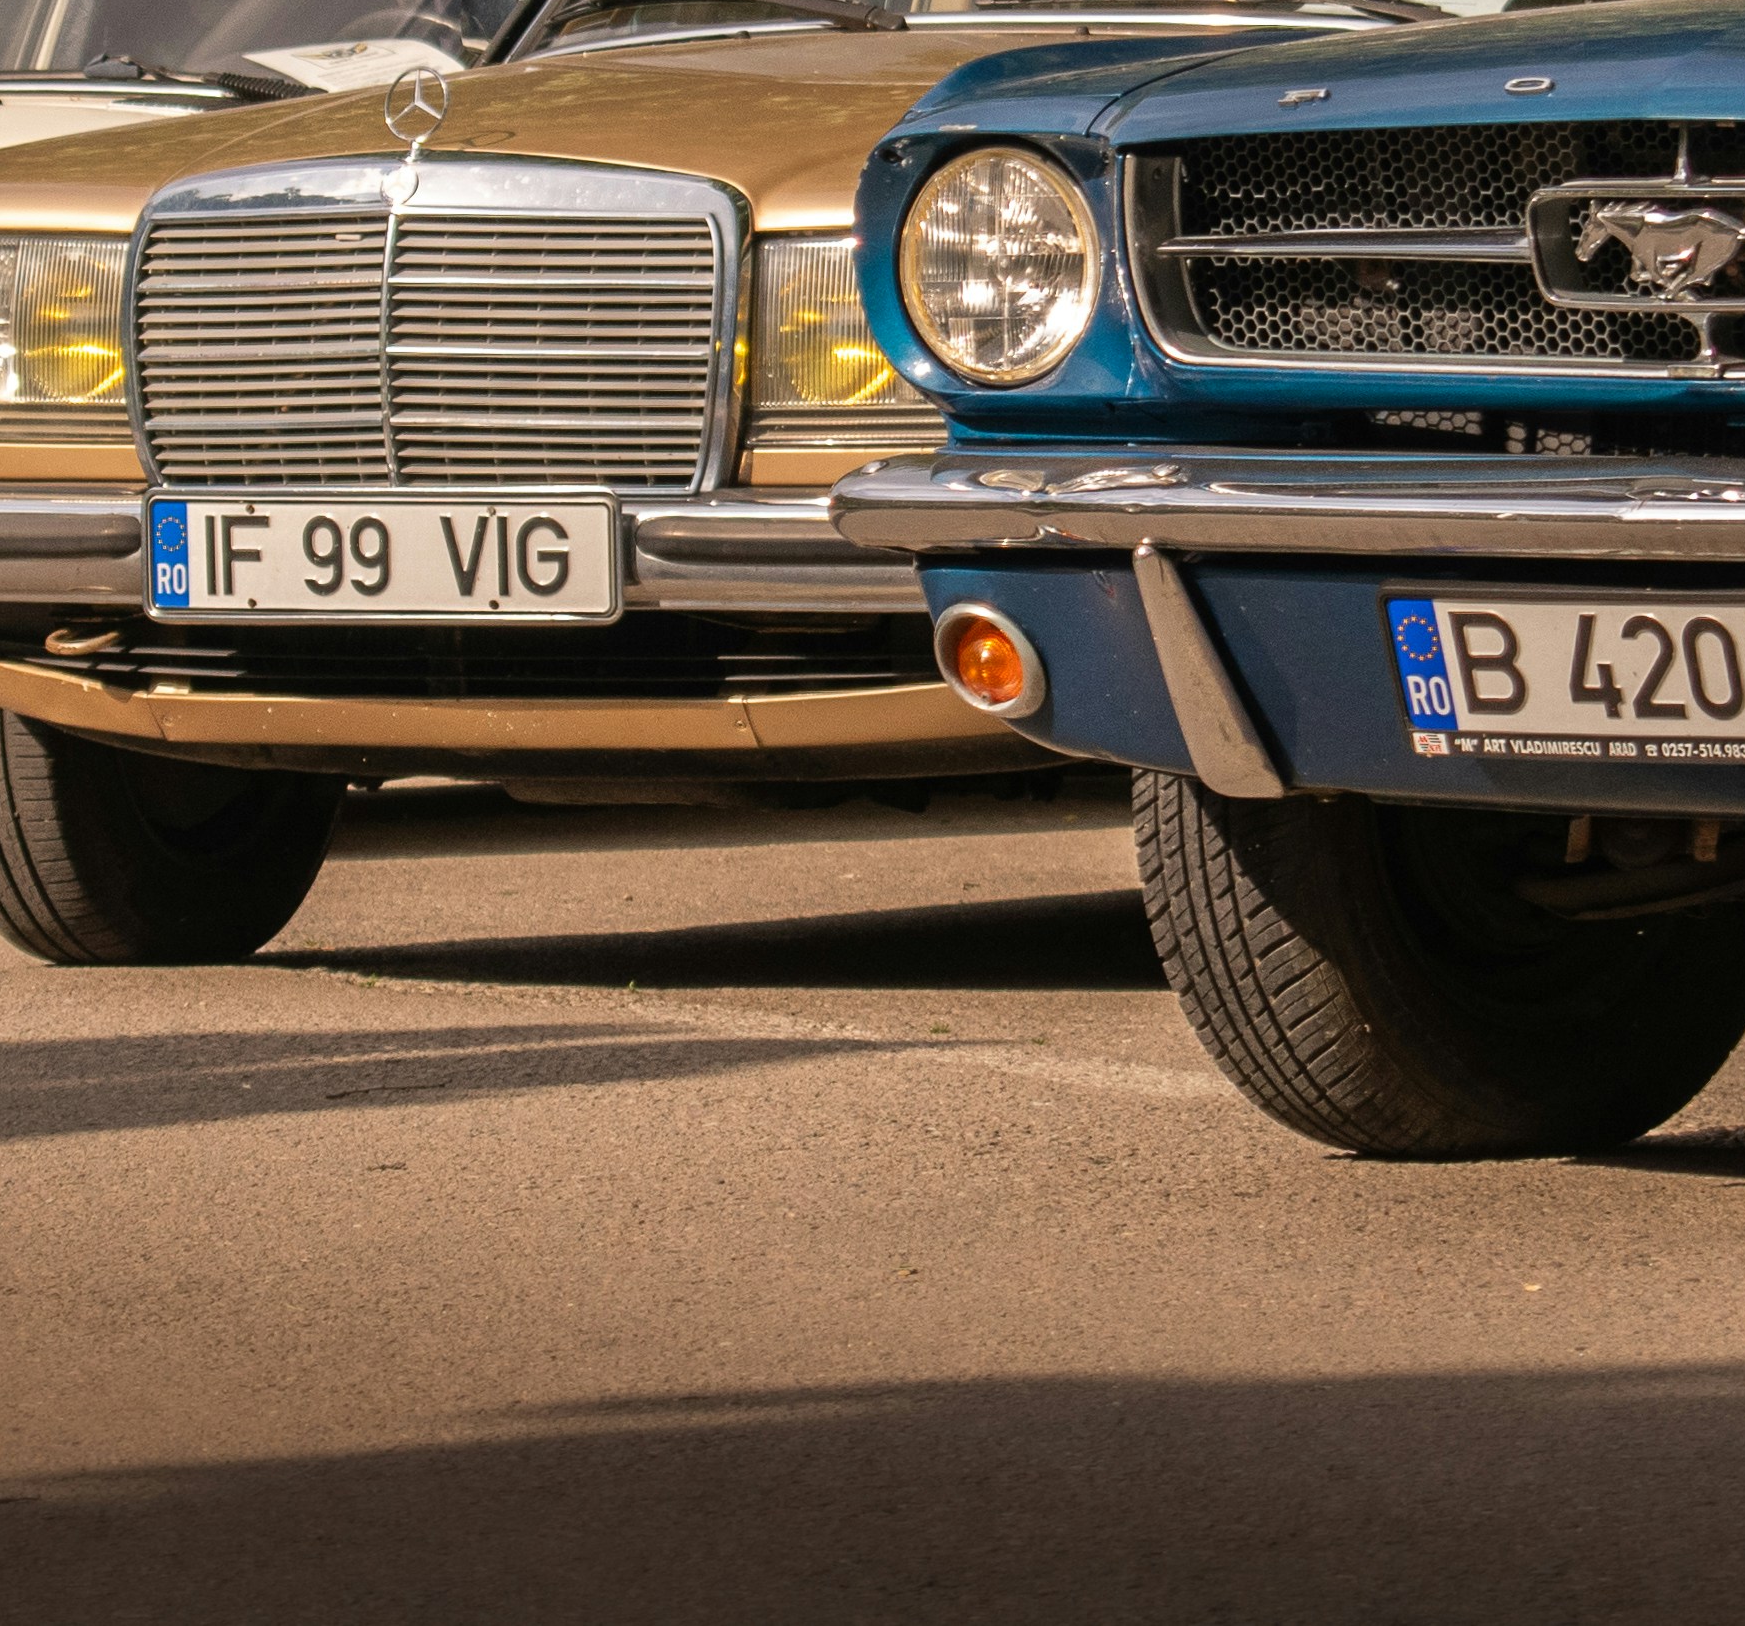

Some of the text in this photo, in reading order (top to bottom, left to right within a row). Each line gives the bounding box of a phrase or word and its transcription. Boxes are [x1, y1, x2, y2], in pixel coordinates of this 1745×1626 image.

[204, 514, 570, 598] IF 99 VIG
[157, 562, 187, 596] RO
[1447, 610, 1528, 716] B
[1406, 674, 1452, 716] RO
[1483, 738, 1506, 754] ART
[1509, 739, 1601, 756] VLADIMIRESCU
[1608, 741, 1638, 757] ARAD
